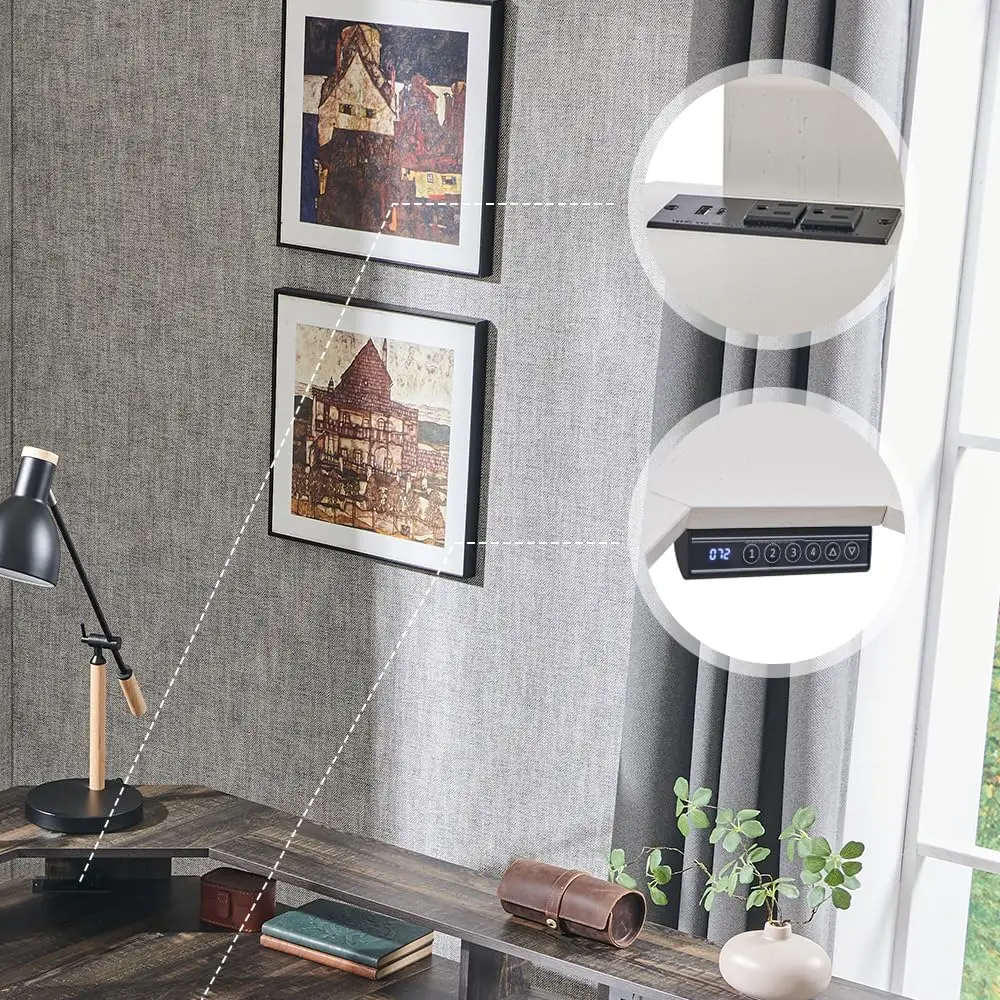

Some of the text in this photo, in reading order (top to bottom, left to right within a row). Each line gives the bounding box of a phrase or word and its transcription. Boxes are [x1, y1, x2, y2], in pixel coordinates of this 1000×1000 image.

[708, 547, 731, 561] 072
[748, 546, 816, 559] 1 2 3 4
